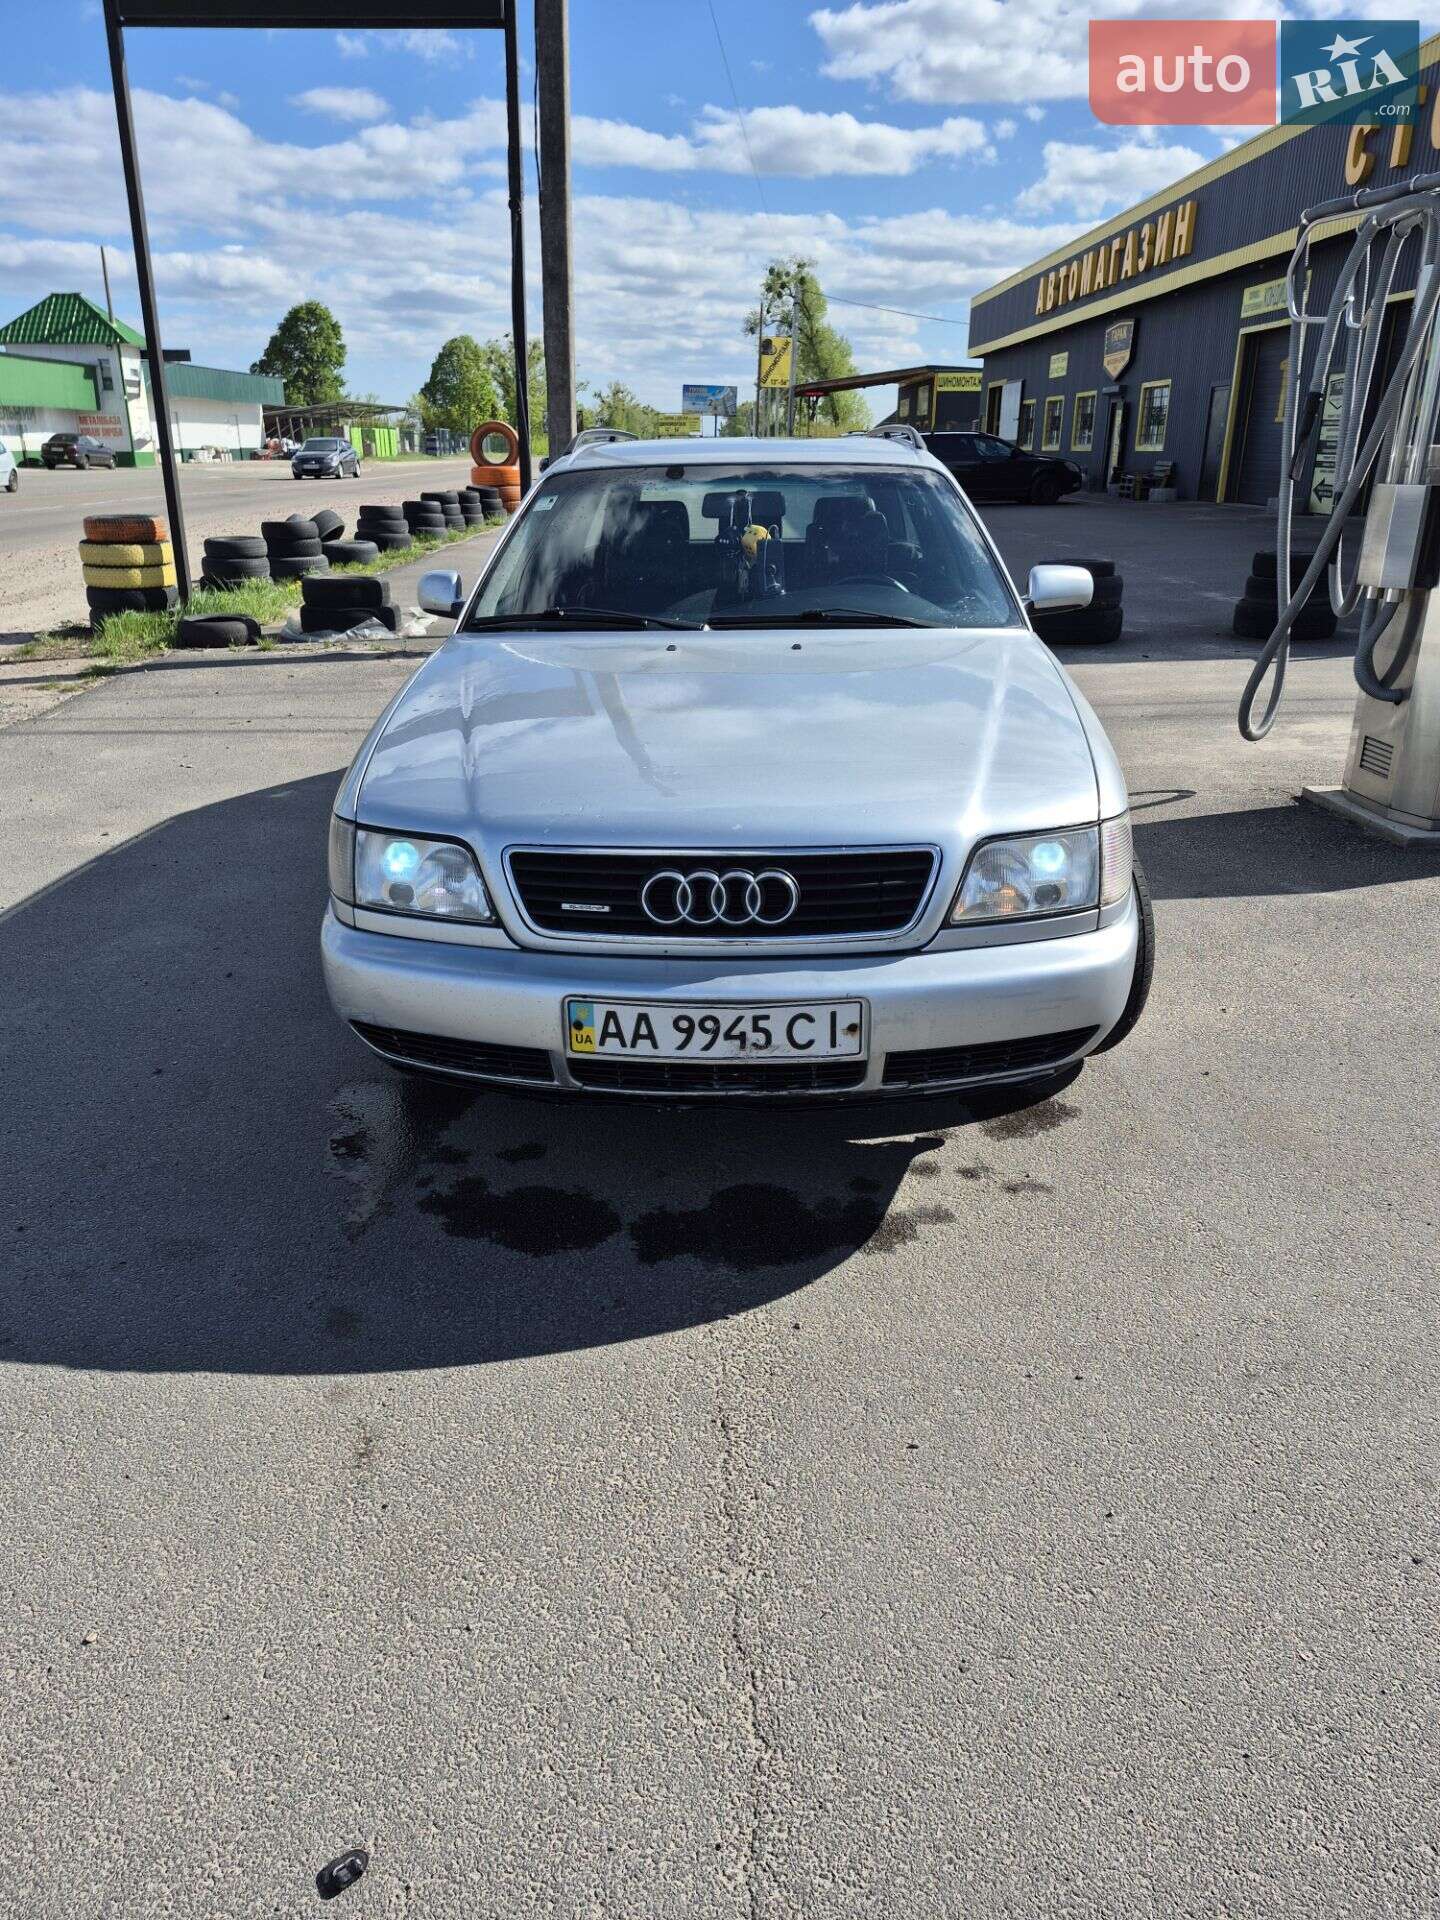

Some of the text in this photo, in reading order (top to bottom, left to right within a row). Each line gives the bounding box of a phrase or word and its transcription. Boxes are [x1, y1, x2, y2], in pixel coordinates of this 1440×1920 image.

[1035, 201, 1197, 316] АВТОМАГАЗИН
[575, 1010, 838, 1051] UA AA 9945 CI
